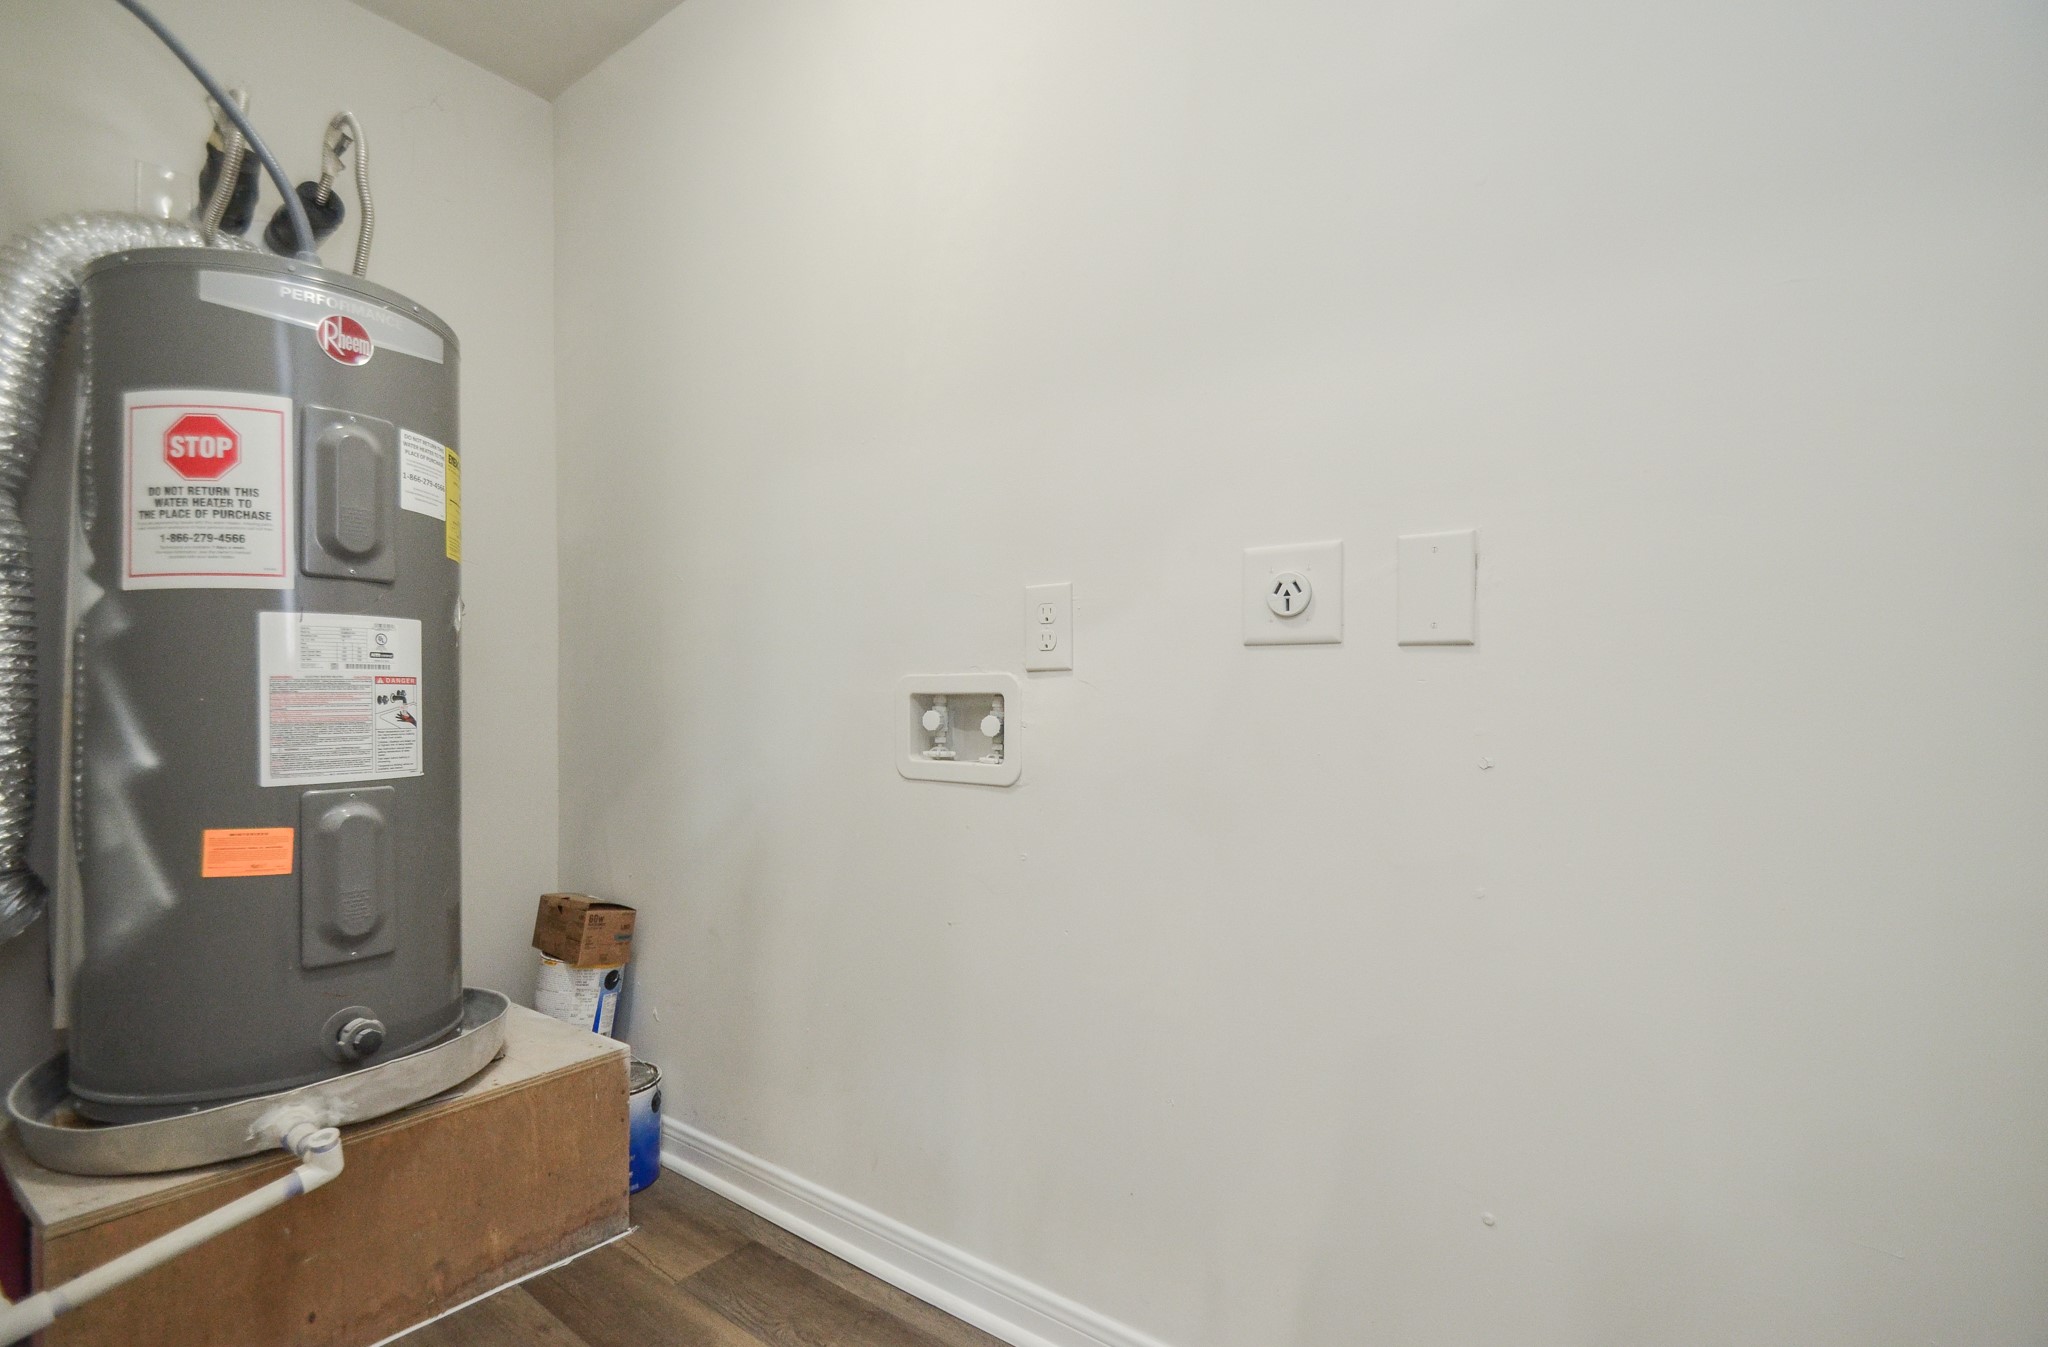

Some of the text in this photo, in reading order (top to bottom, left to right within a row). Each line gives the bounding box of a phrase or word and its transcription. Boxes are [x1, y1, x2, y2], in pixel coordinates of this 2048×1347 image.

[279, 286, 403, 330] PERFORMANCE
[324, 316, 370, 356] Rheem
[170, 435, 233, 458] STOP
[148, 487, 260, 498] DO NOT RETURN THIS
[154, 498, 252, 508] WATER HEATER TO
[139, 510, 272, 520] THE PLACE OF PURCHASE
[160, 533, 246, 543] 1-866-279-4566
